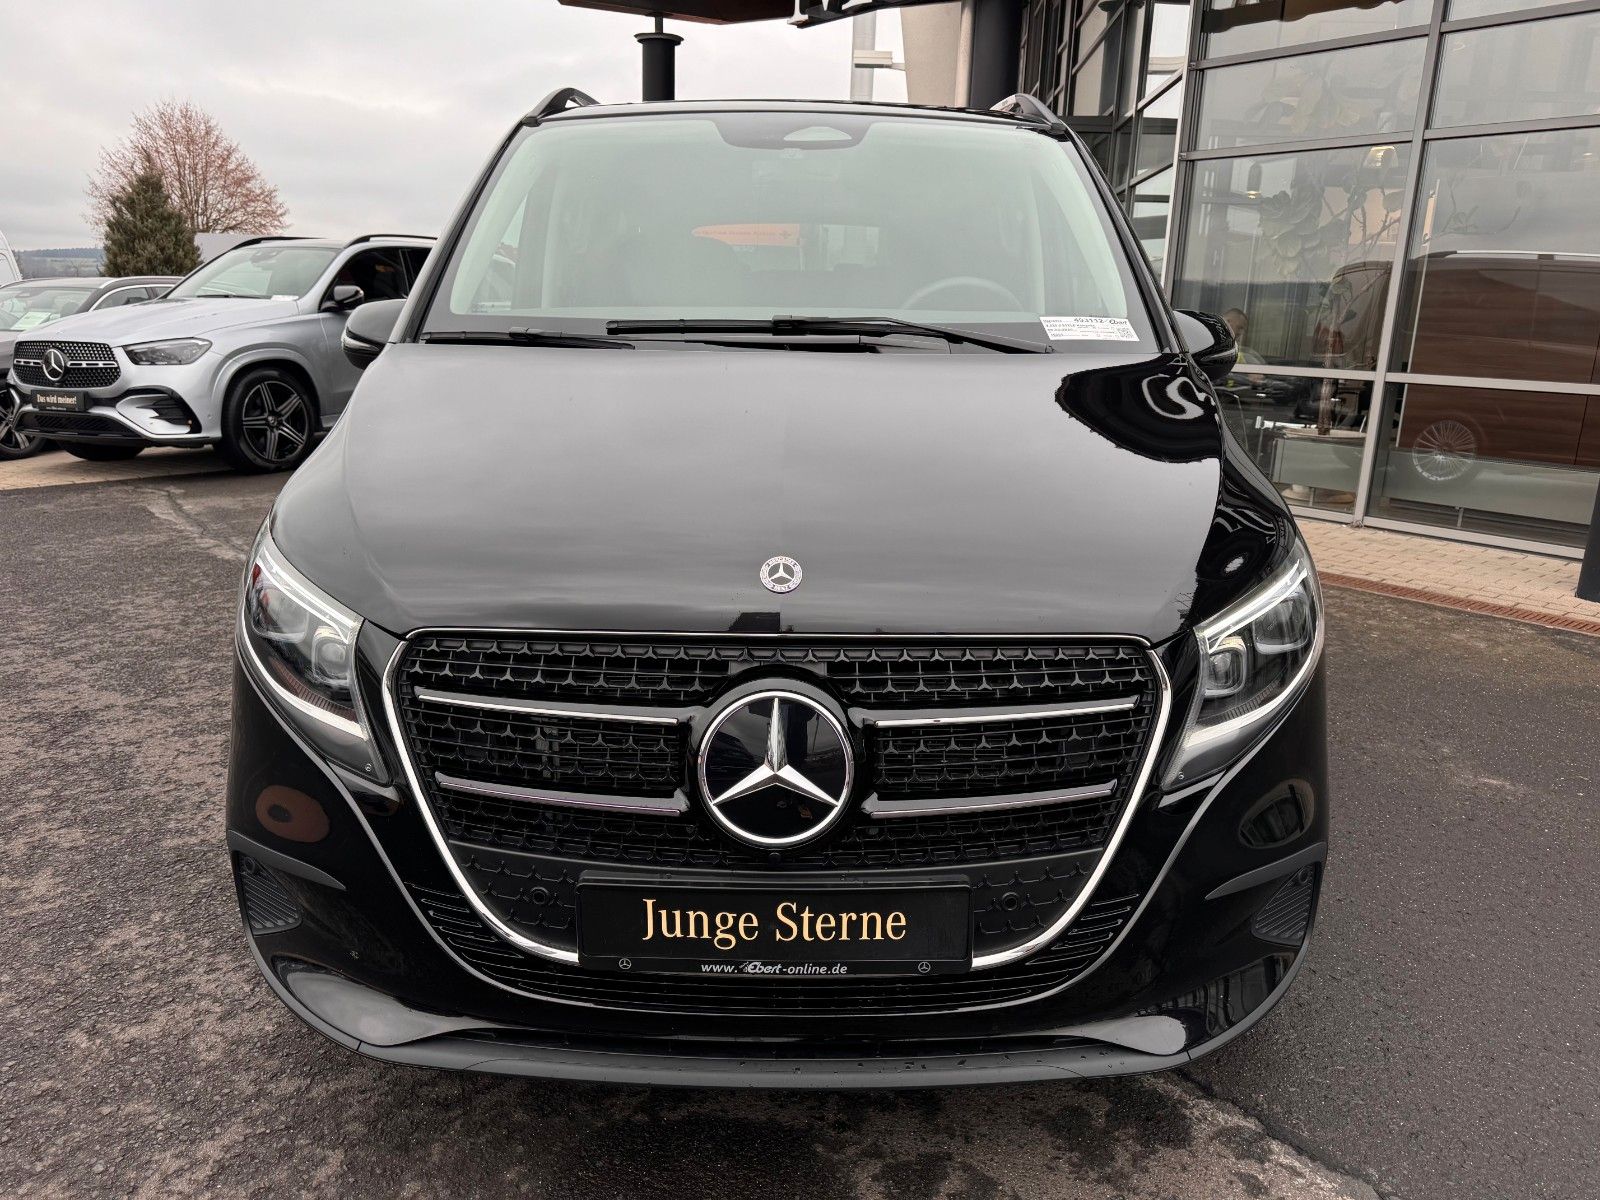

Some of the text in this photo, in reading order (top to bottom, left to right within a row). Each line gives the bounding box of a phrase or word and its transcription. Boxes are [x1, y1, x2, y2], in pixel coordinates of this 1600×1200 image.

[46, 394, 57, 404] wird
[57, 395, 77, 405] meiner!
[642, 898, 908, 950] Junge Sterne
